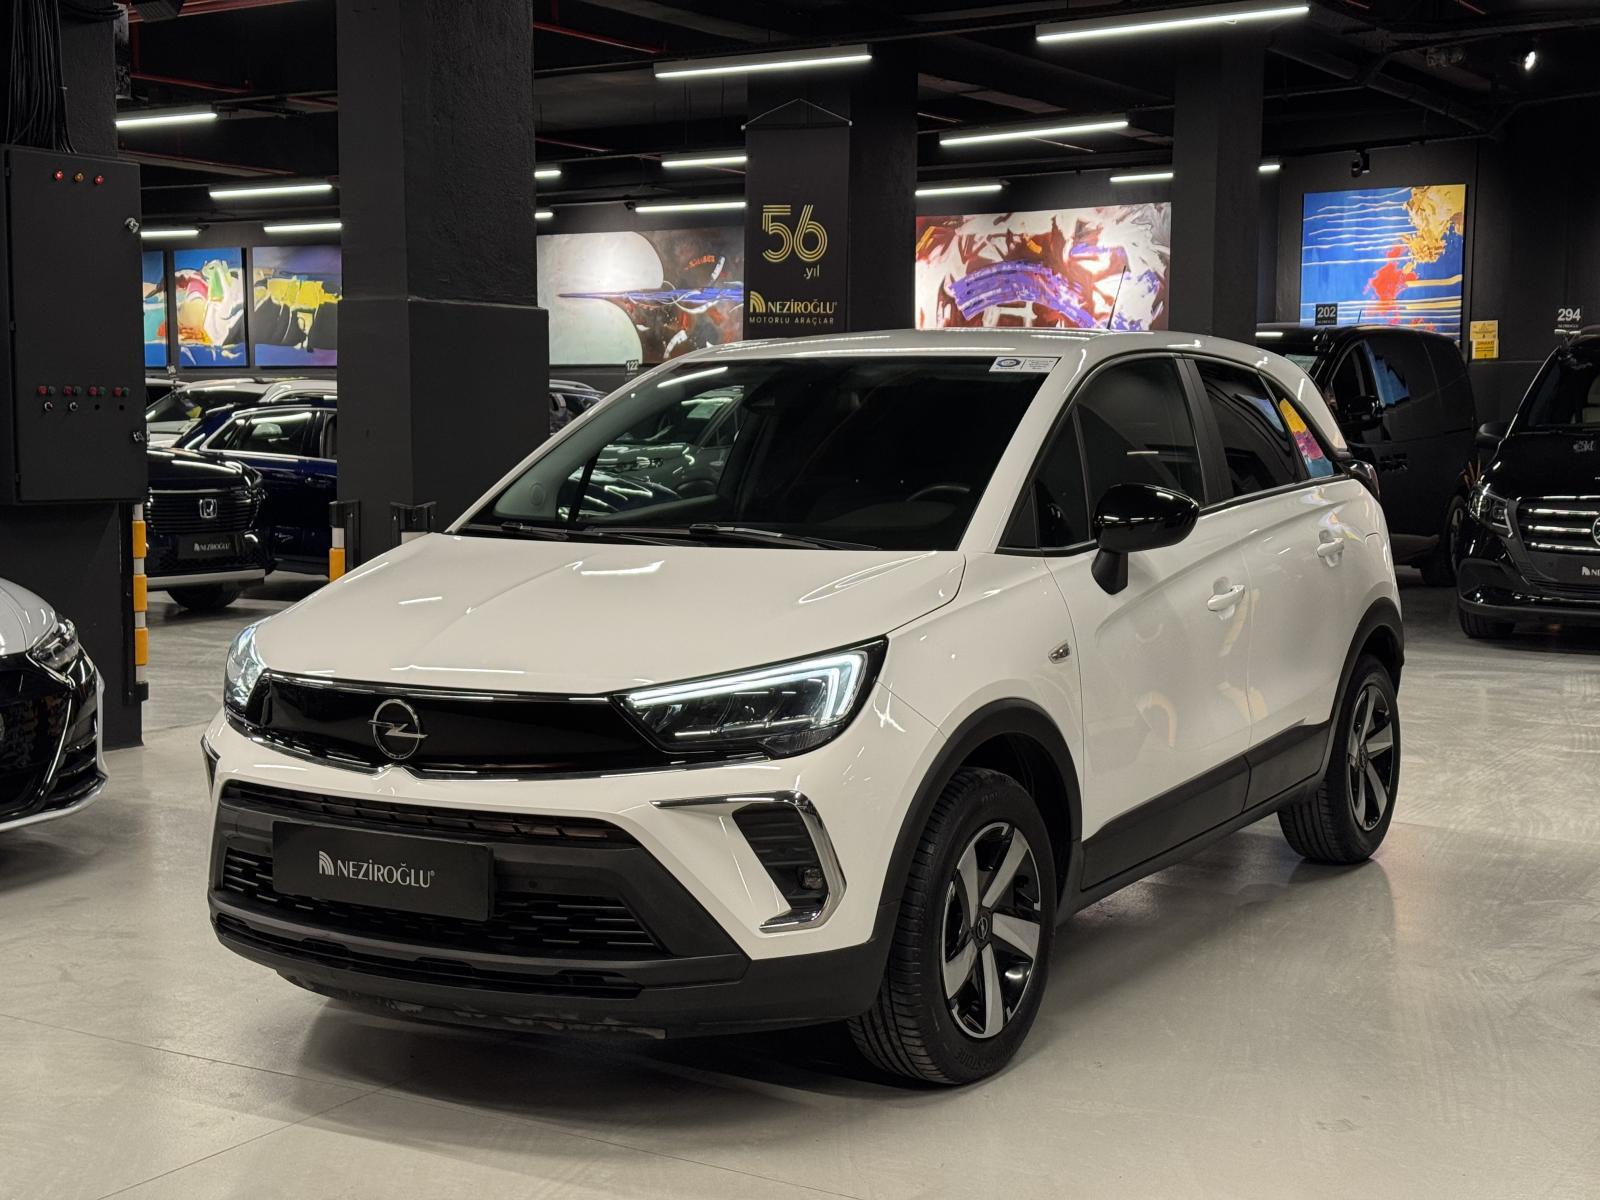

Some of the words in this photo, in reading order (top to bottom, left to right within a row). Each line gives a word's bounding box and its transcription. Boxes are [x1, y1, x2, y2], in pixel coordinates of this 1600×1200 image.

[762, 204, 828, 263] 56
[767, 298, 835, 314] NEZİROĞLU
[1317, 306, 1336, 318] 202
[749, 316, 790, 325] MOTORLU
[794, 316, 834, 326] ARAÇLAR
[1557, 308, 1581, 321] 294
[337, 858, 431, 888] NEZİROĞLU
